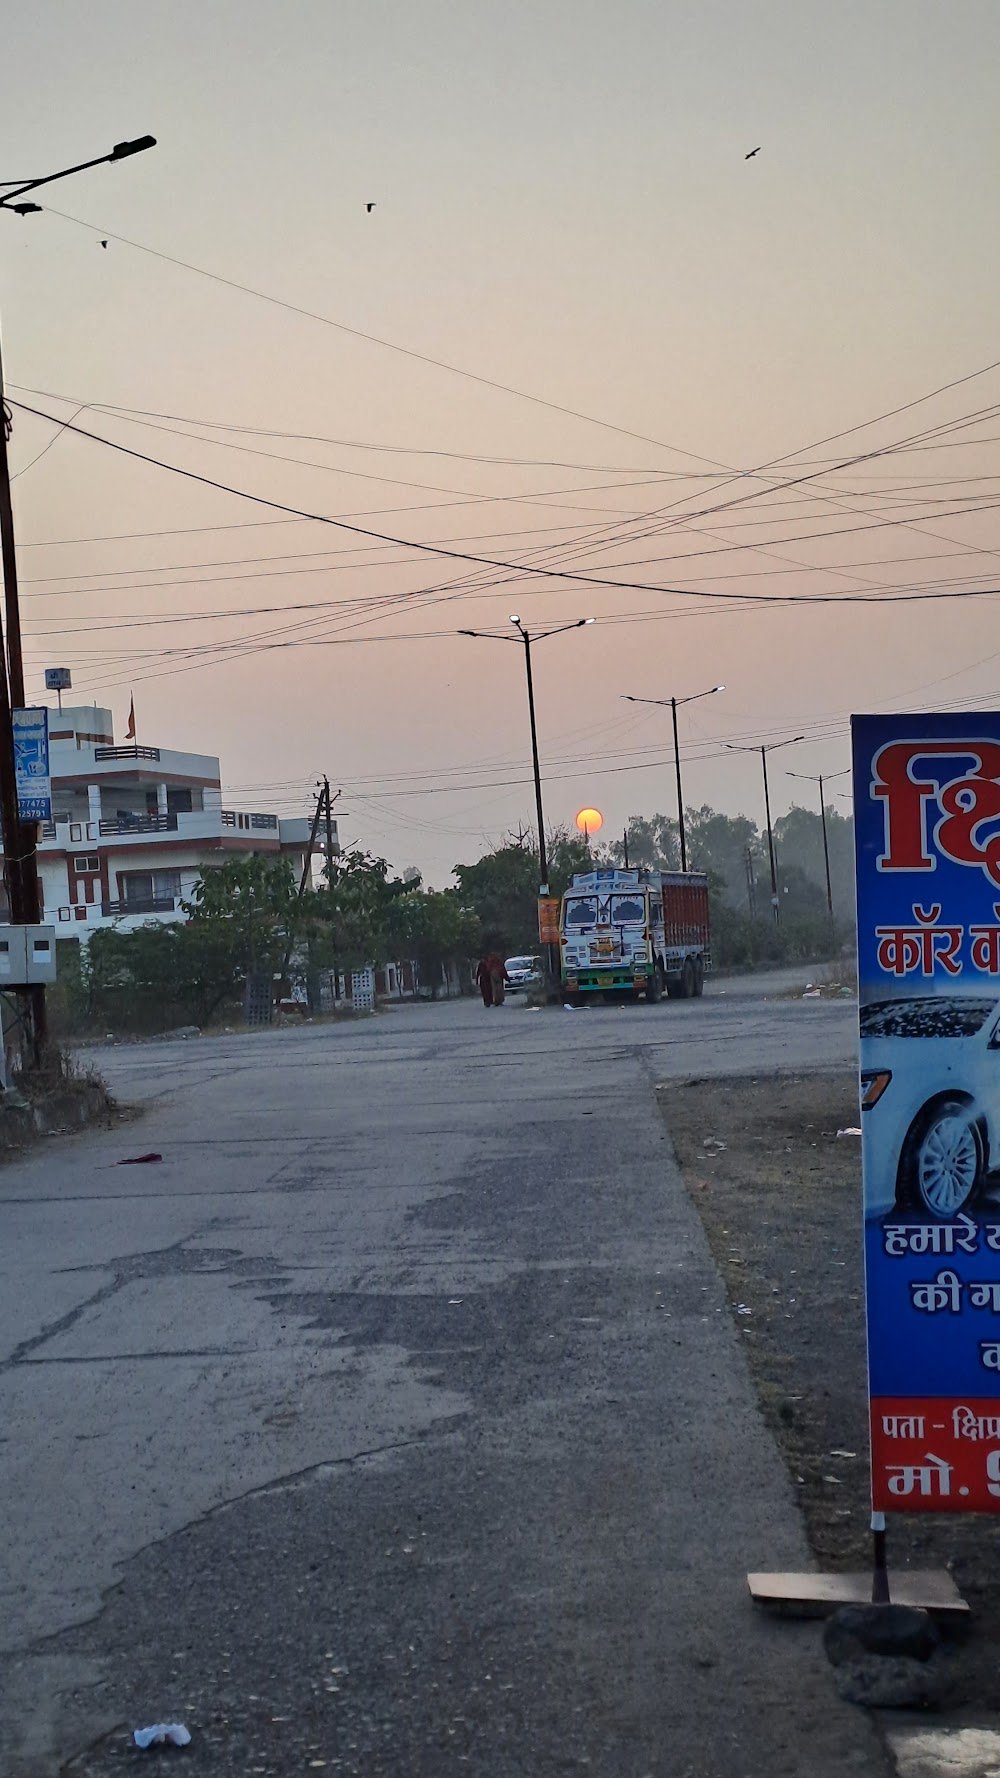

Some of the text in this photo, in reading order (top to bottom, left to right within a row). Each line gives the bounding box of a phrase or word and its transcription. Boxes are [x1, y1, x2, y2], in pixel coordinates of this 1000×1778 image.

[875, 903, 964, 978] कॉर
[883, 1212, 978, 1255] हमारे
[912, 1270, 963, 1312] की
